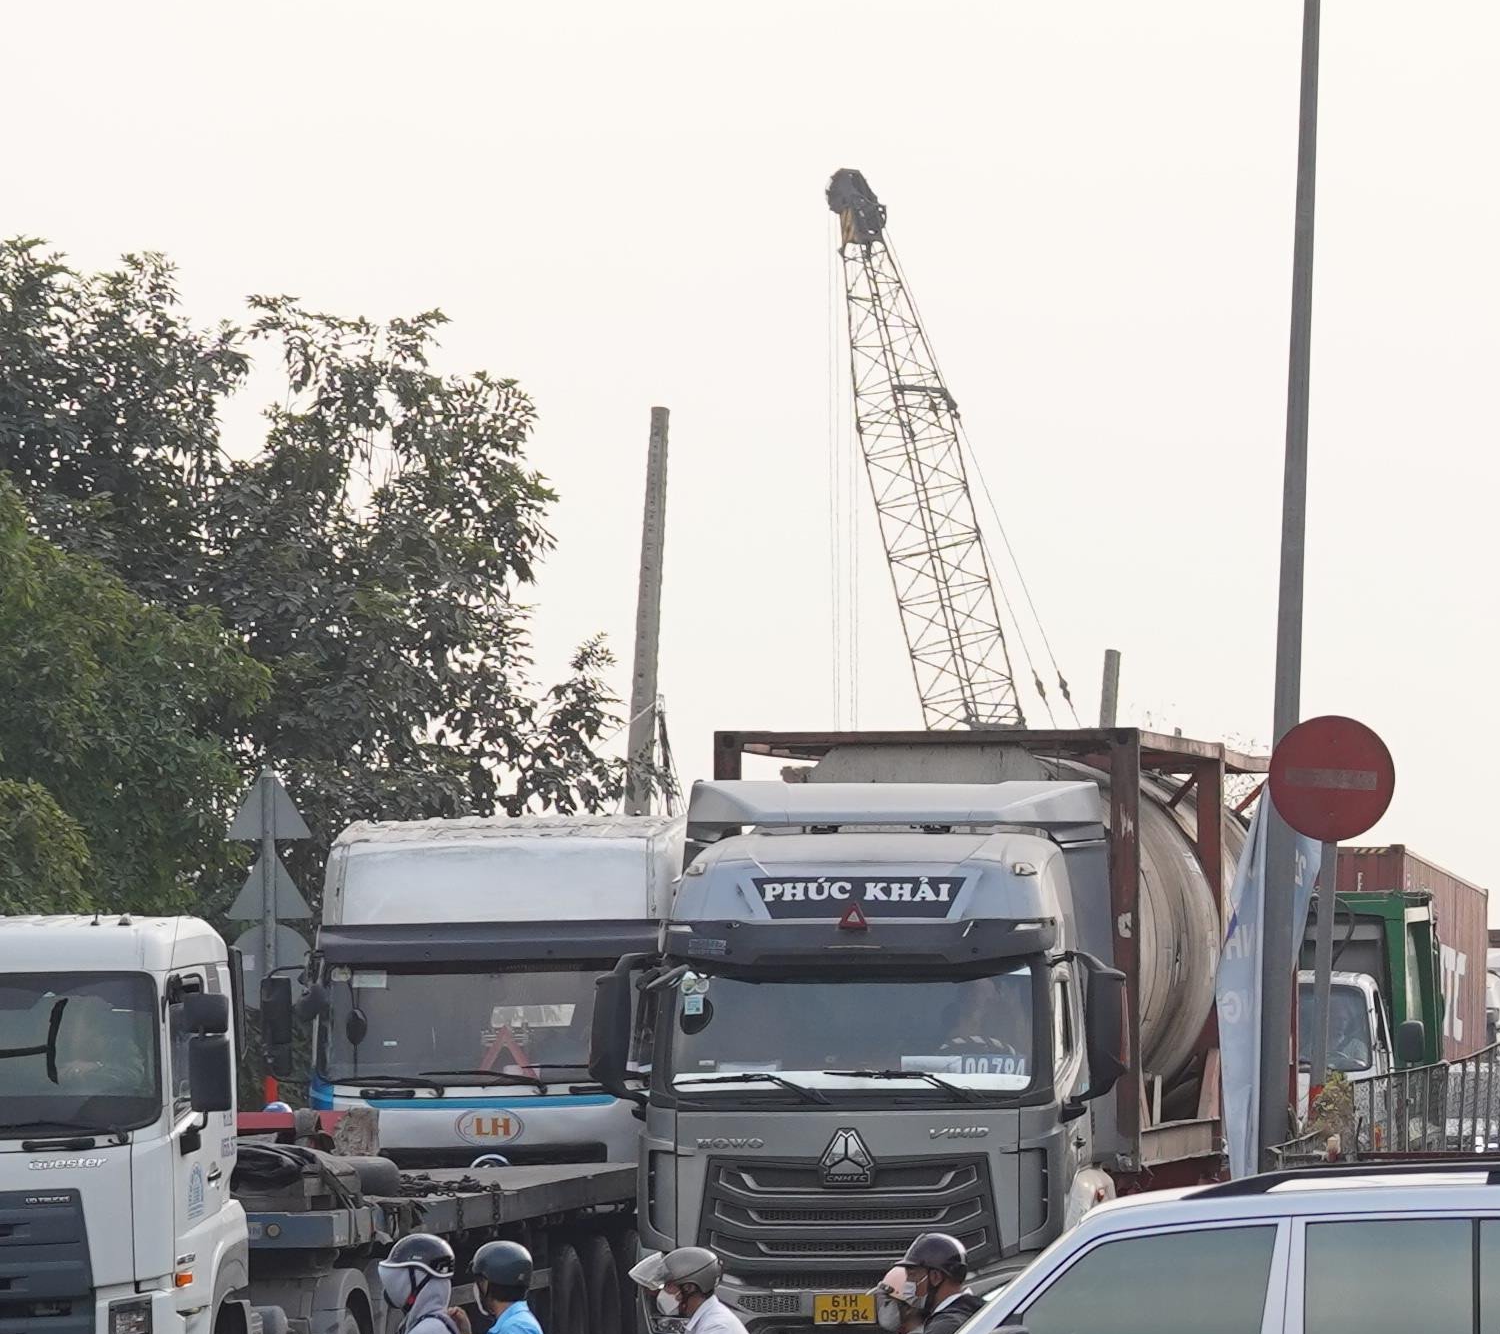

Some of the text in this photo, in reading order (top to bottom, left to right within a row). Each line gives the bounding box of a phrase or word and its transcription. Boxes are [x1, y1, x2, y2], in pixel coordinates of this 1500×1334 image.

[762, 876, 950, 901] PHÚC KHẢI
[475, 1118, 510, 1135] LH
[29, 1158, 107, 1170] Quester
[832, 1295, 858, 1308] 61H
[821, 1309, 869, 1323] 097.84
